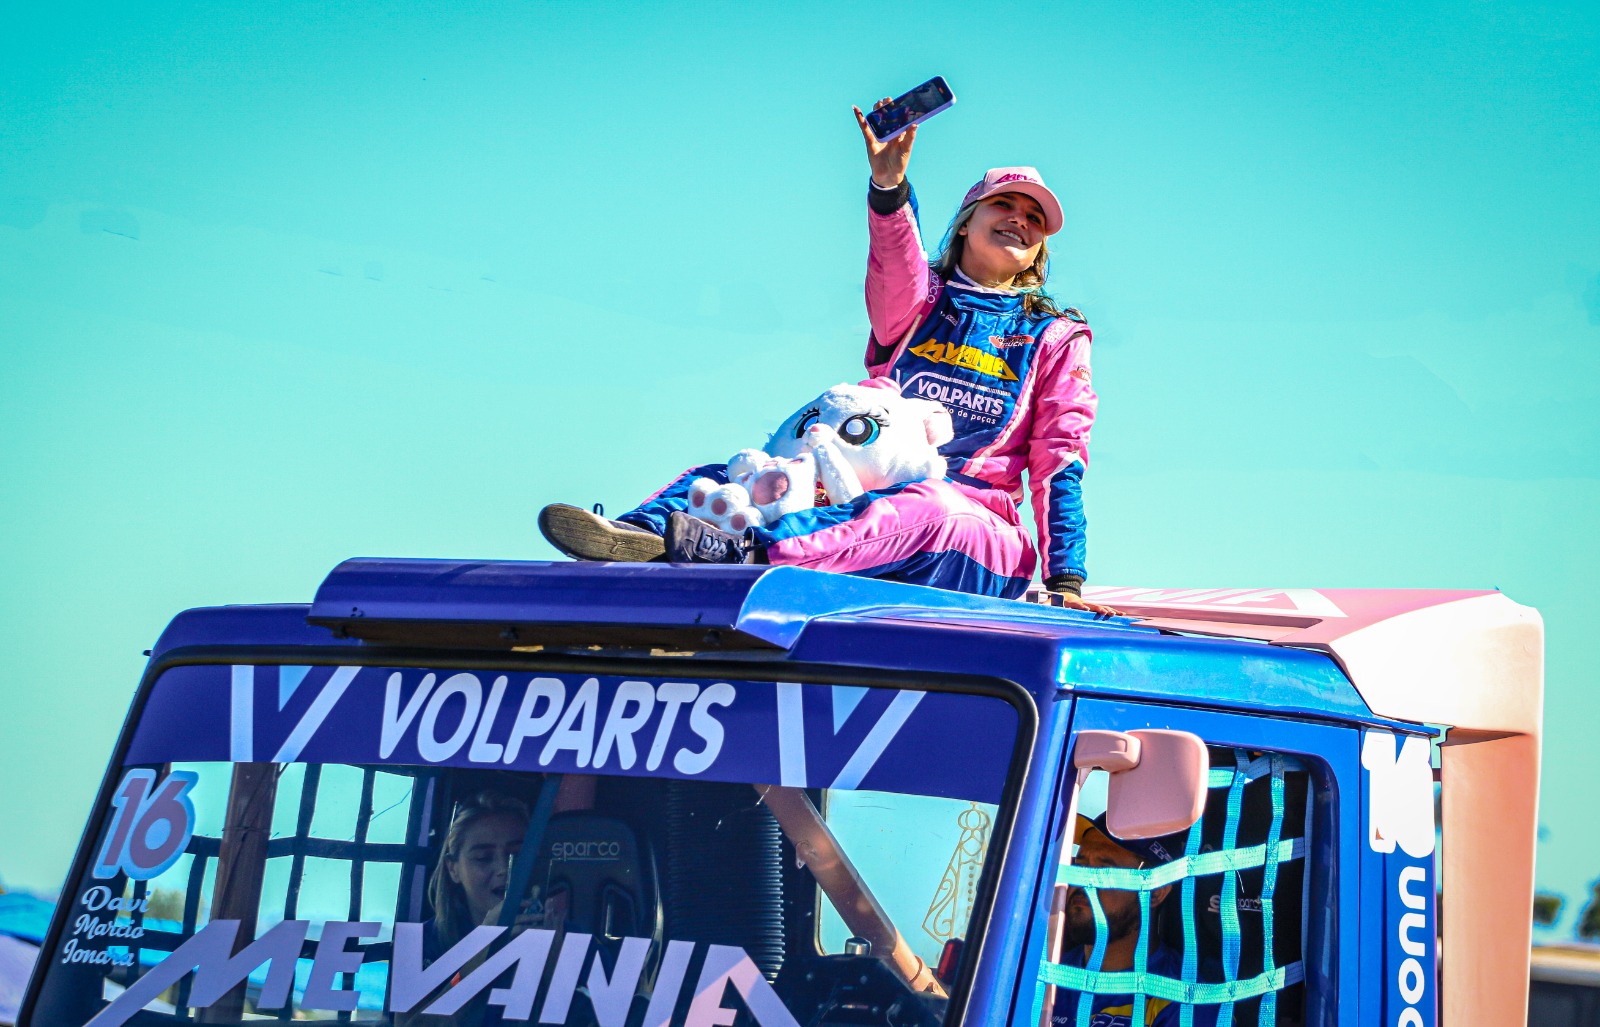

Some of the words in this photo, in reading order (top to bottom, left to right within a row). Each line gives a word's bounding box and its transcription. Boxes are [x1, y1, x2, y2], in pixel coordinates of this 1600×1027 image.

[957, 409, 968, 418] de
[971, 414, 997, 425] peças
[379, 671, 737, 775] VOLPARTS
[93, 768, 198, 881] 16
[551, 841, 620, 861] sparco
[81, 885, 151, 913] Davi
[73, 913, 145, 939] Marcio
[82, 919, 801, 1027] MEVANIA
